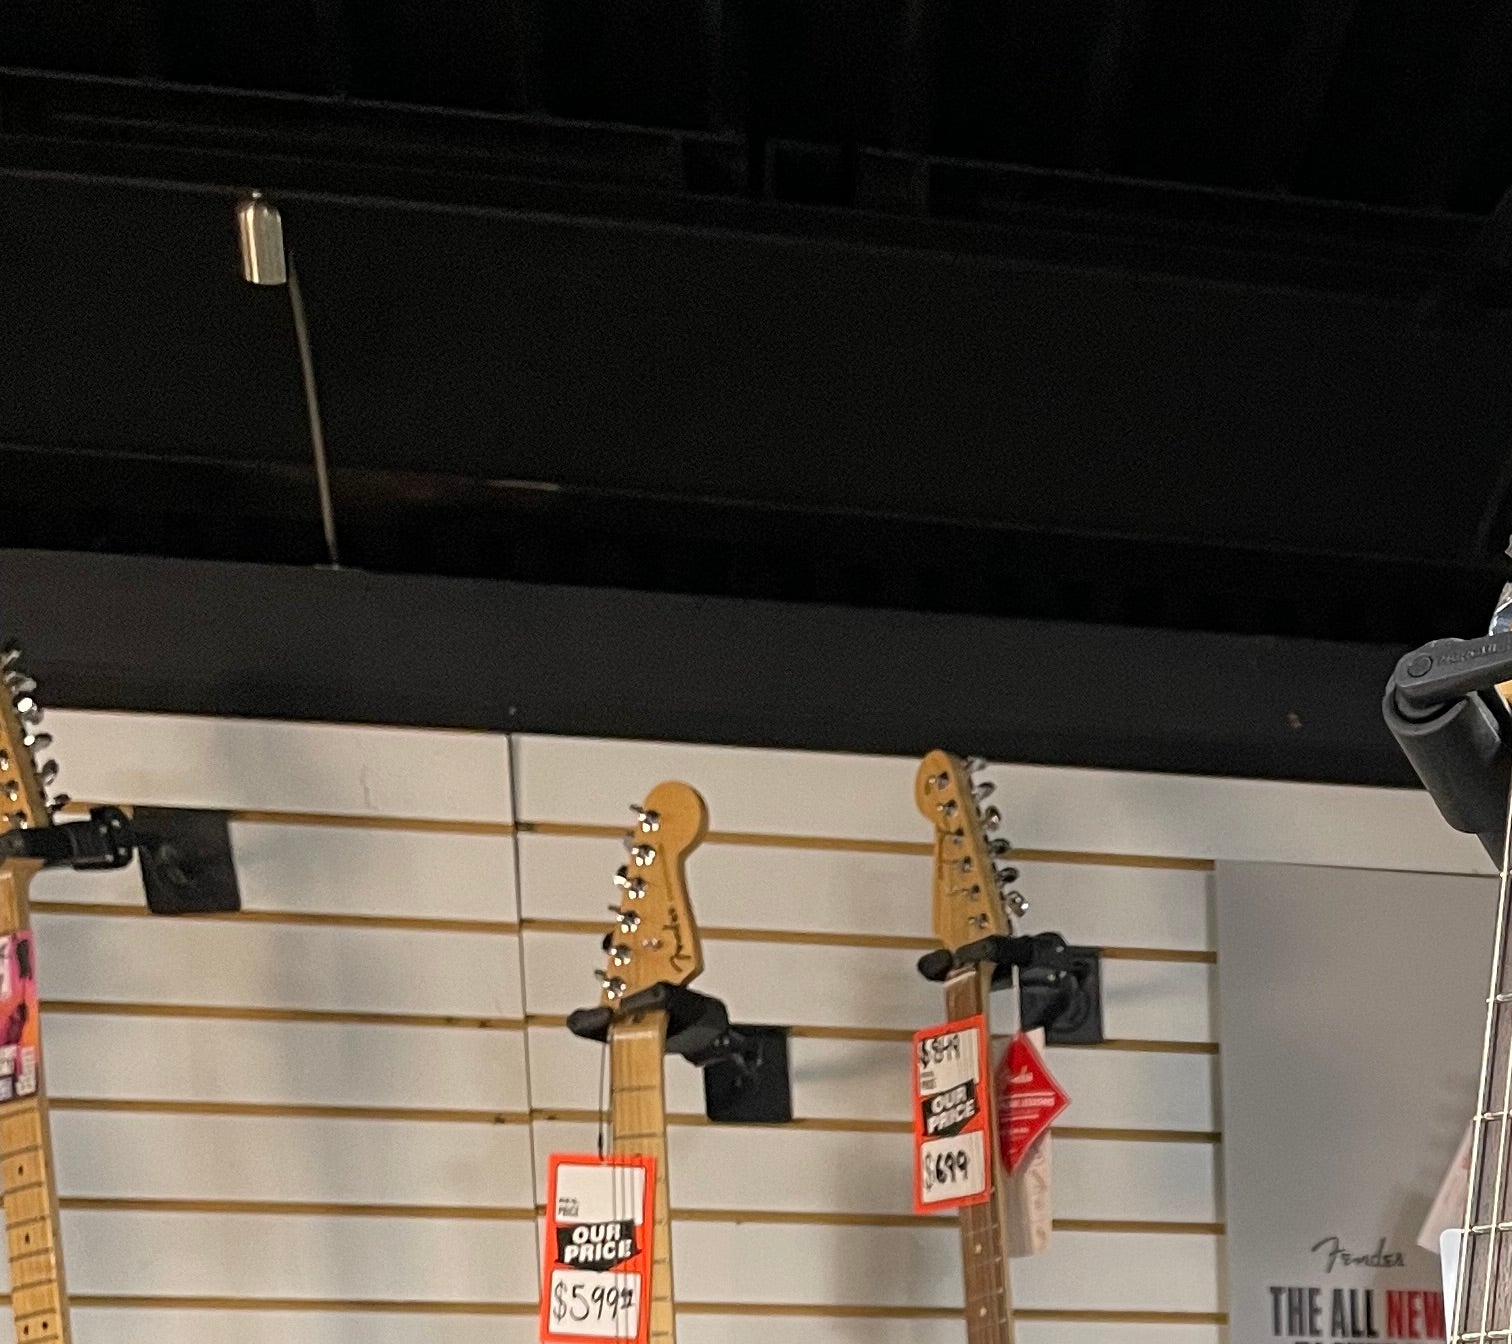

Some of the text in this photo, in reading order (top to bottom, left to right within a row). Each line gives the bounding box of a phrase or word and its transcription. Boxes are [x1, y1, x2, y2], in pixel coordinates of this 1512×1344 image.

[926, 1099, 976, 1134] PRICE
[931, 1085, 967, 1113] OUR
[572, 1223, 621, 1244] OUR
[1311, 1237, 1404, 1273] Fender
[1270, 1286, 1323, 1337] THE
[1331, 1288, 1379, 1339] ALL
